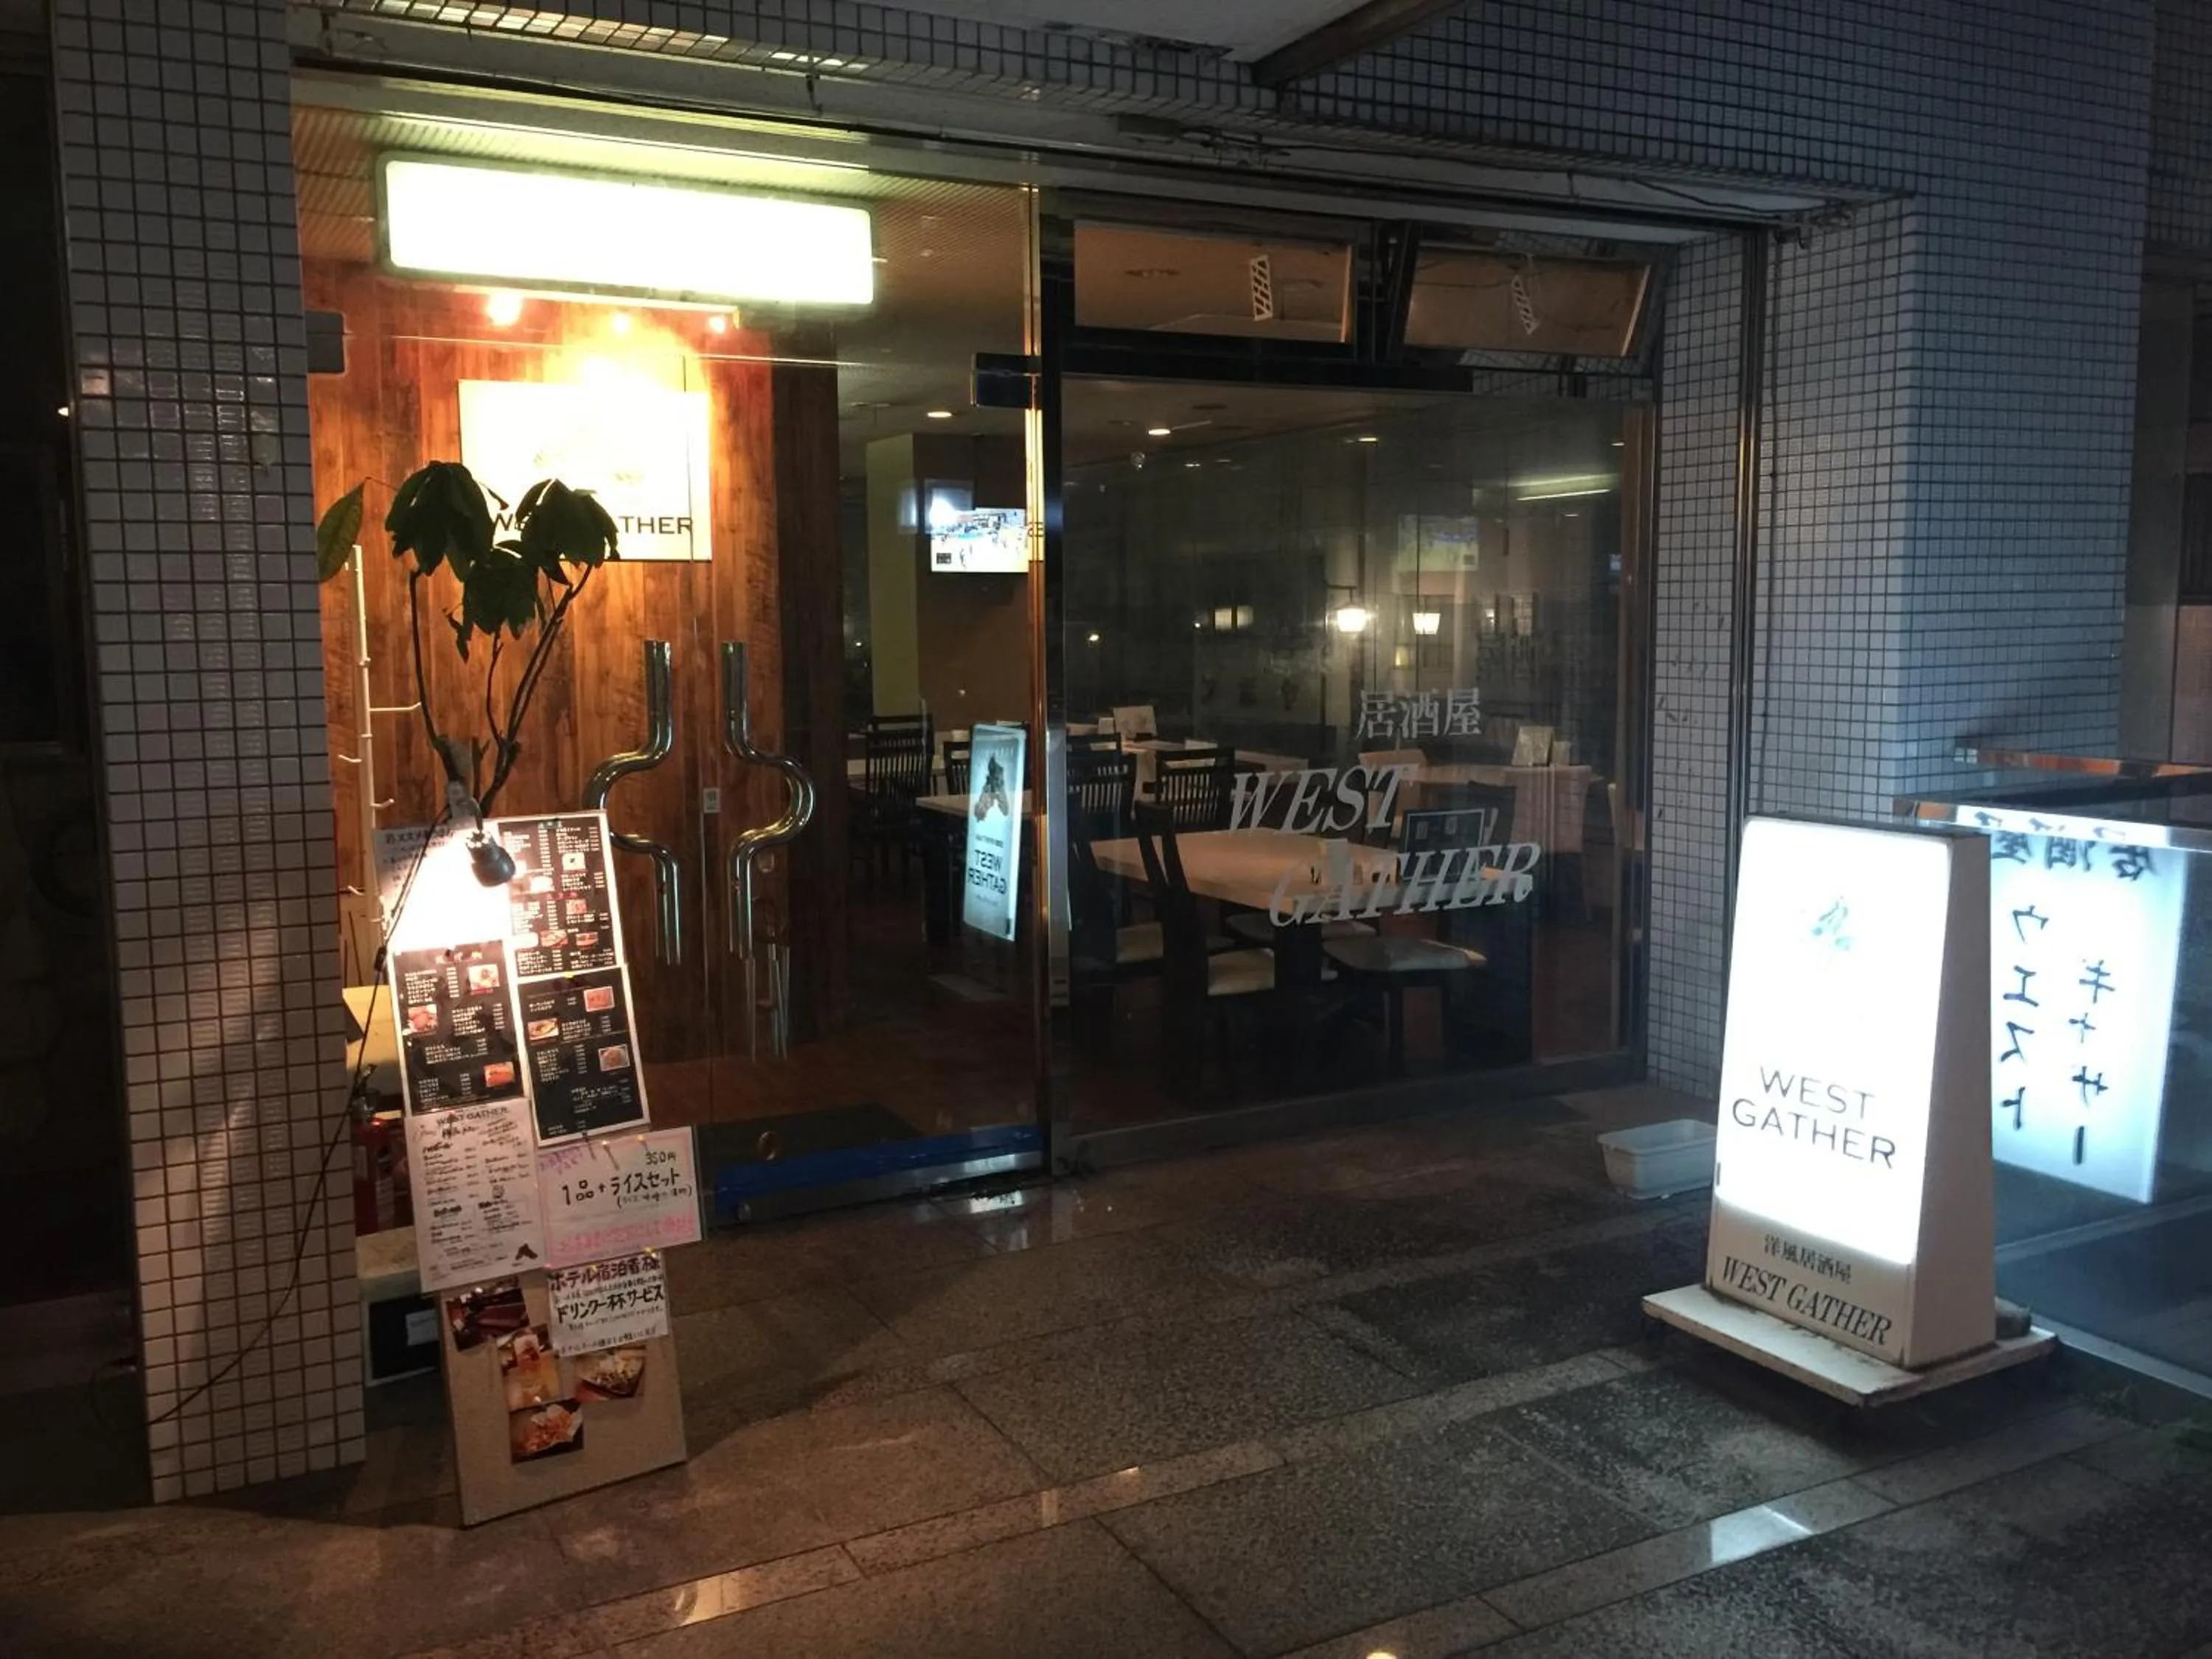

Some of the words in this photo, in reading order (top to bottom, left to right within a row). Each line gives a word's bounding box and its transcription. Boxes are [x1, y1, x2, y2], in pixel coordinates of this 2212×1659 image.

[1357, 687, 1482, 739] 居酒屋
[1228, 764, 1420, 835] WEST
[1269, 843, 1542, 928] GATHER
[1759, 1066, 1876, 1119] WEST
[1732, 1098, 1896, 1169] GATHER
[1763, 1233, 1852, 1286] 洋風居酒屋
[1722, 1256, 1787, 1302] WEST
[1787, 1282, 1893, 1346] GATHER
